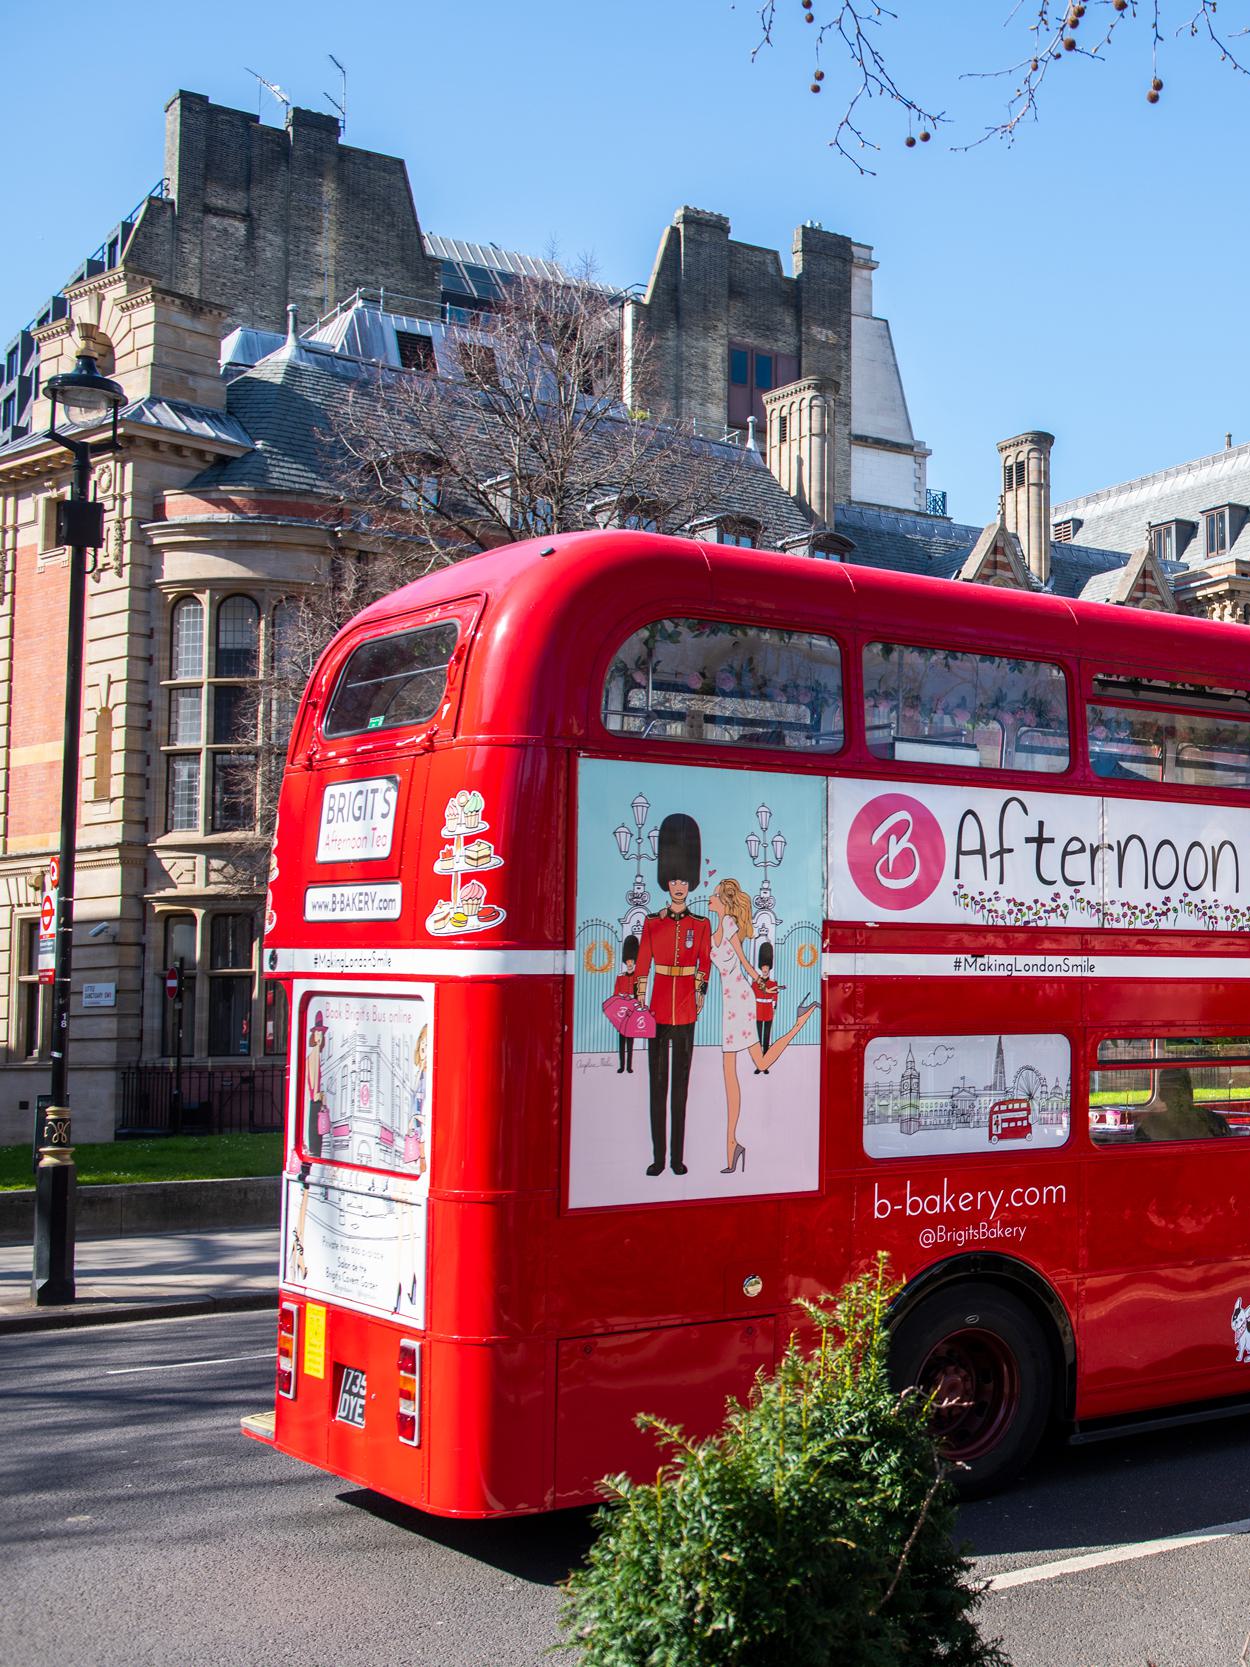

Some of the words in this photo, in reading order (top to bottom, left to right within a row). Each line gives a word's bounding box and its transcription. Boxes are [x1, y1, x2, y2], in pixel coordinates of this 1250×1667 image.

[371, 827, 388, 849] Tea
[954, 796, 1241, 893] Afternoon
[312, 891, 396, 913] www.B-BAKERY.com
[314, 951, 392, 973] #MakingLondonSmile
[953, 955, 1096, 976] #MakingLondonSmile
[873, 1177, 1067, 1220] b-bakery.com
[919, 1220, 1027, 1249] @BrigitsBakery
[345, 1369, 367, 1396] 735
[339, 1392, 366, 1423] DYE
